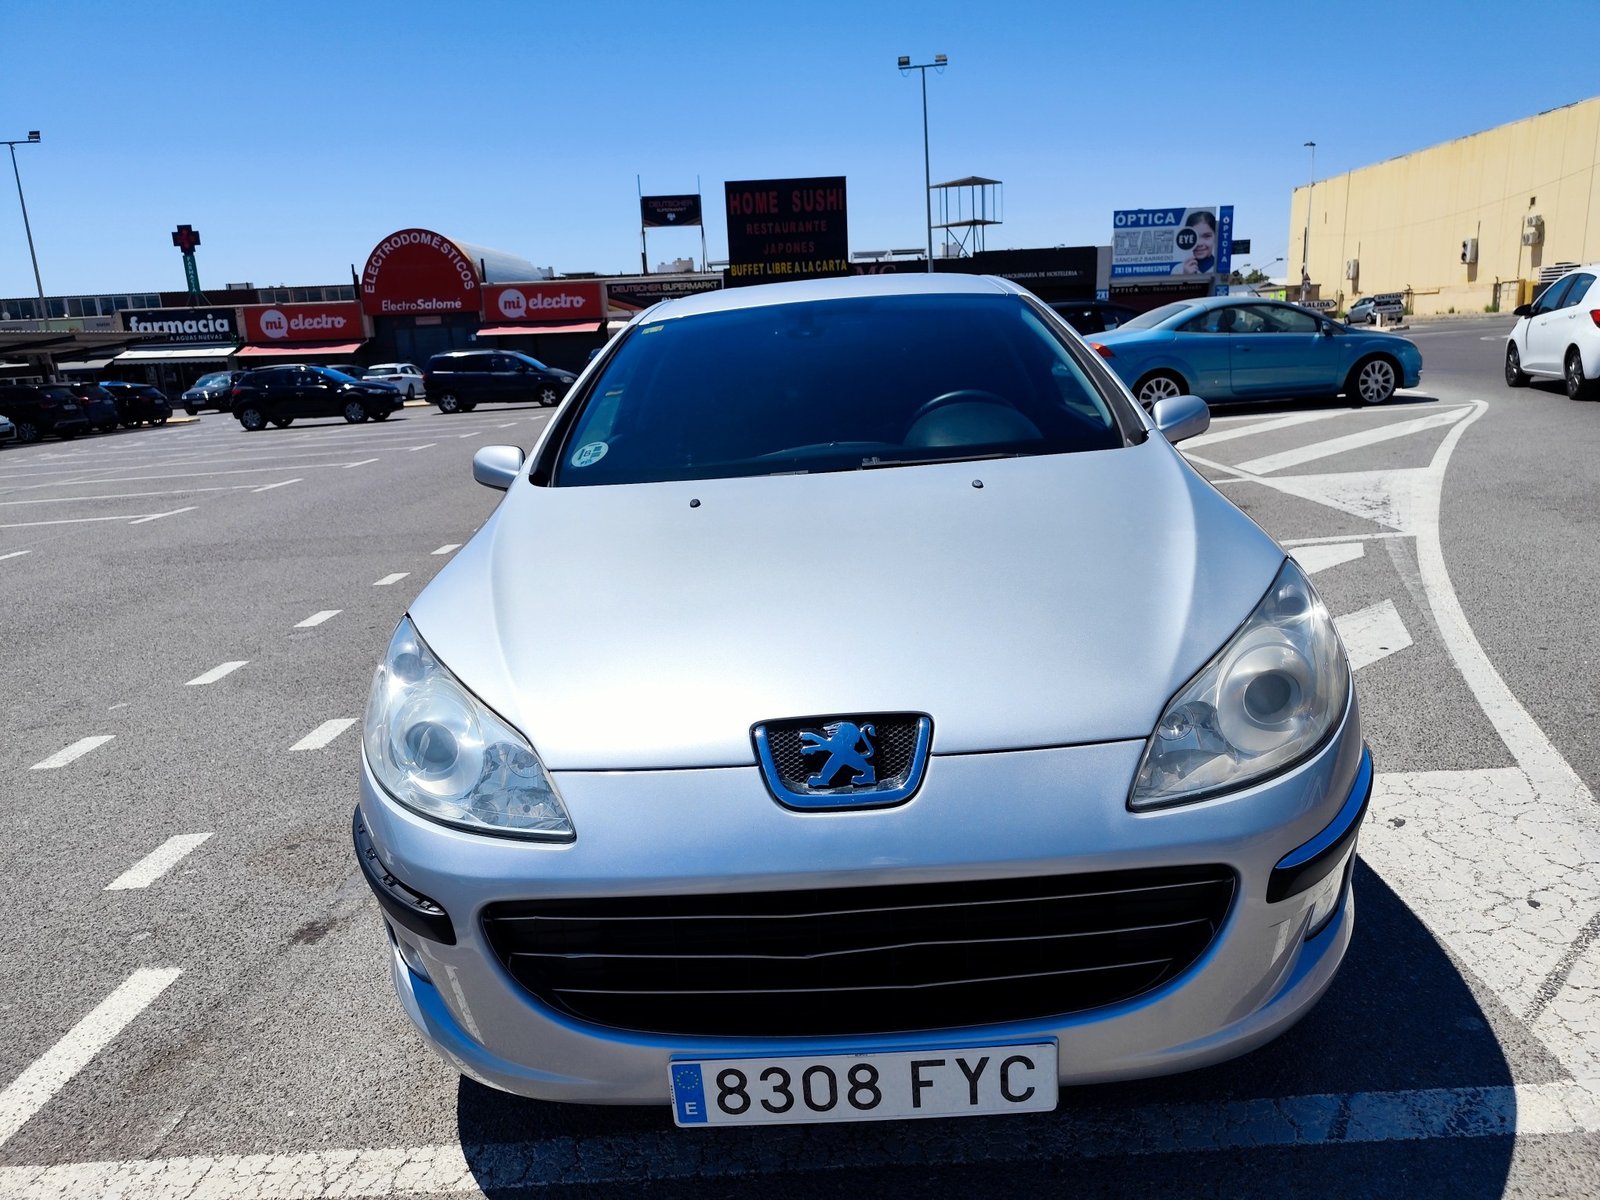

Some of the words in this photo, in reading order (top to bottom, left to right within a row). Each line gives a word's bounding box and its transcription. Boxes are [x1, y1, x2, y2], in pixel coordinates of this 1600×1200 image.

[729, 191, 779, 215] HOME
[792, 188, 844, 212] SUSHI
[1115, 211, 1176, 226] ÓPTICA
[746, 220, 828, 235] RESTAURANTE
[1178, 234, 1195, 245] EYE
[364, 232, 475, 294] ELECTRODOMÉSTICOS
[731, 263, 765, 276] BUFFET
[766, 261, 793, 274] LIBRE
[815, 258, 849, 272] CARTA
[611, 283, 661, 294] DEUTSCHER
[662, 280, 719, 291] SUPERMARKT
[503, 296, 523, 310] mi
[528, 292, 586, 309] electro
[129, 313, 230, 334] farmacia
[265, 316, 284, 330] mi
[290, 313, 347, 330] electro
[715, 1061, 882, 1115] 8308
[909, 1055, 1037, 1109] FYC
[684, 1101, 699, 1116] E
